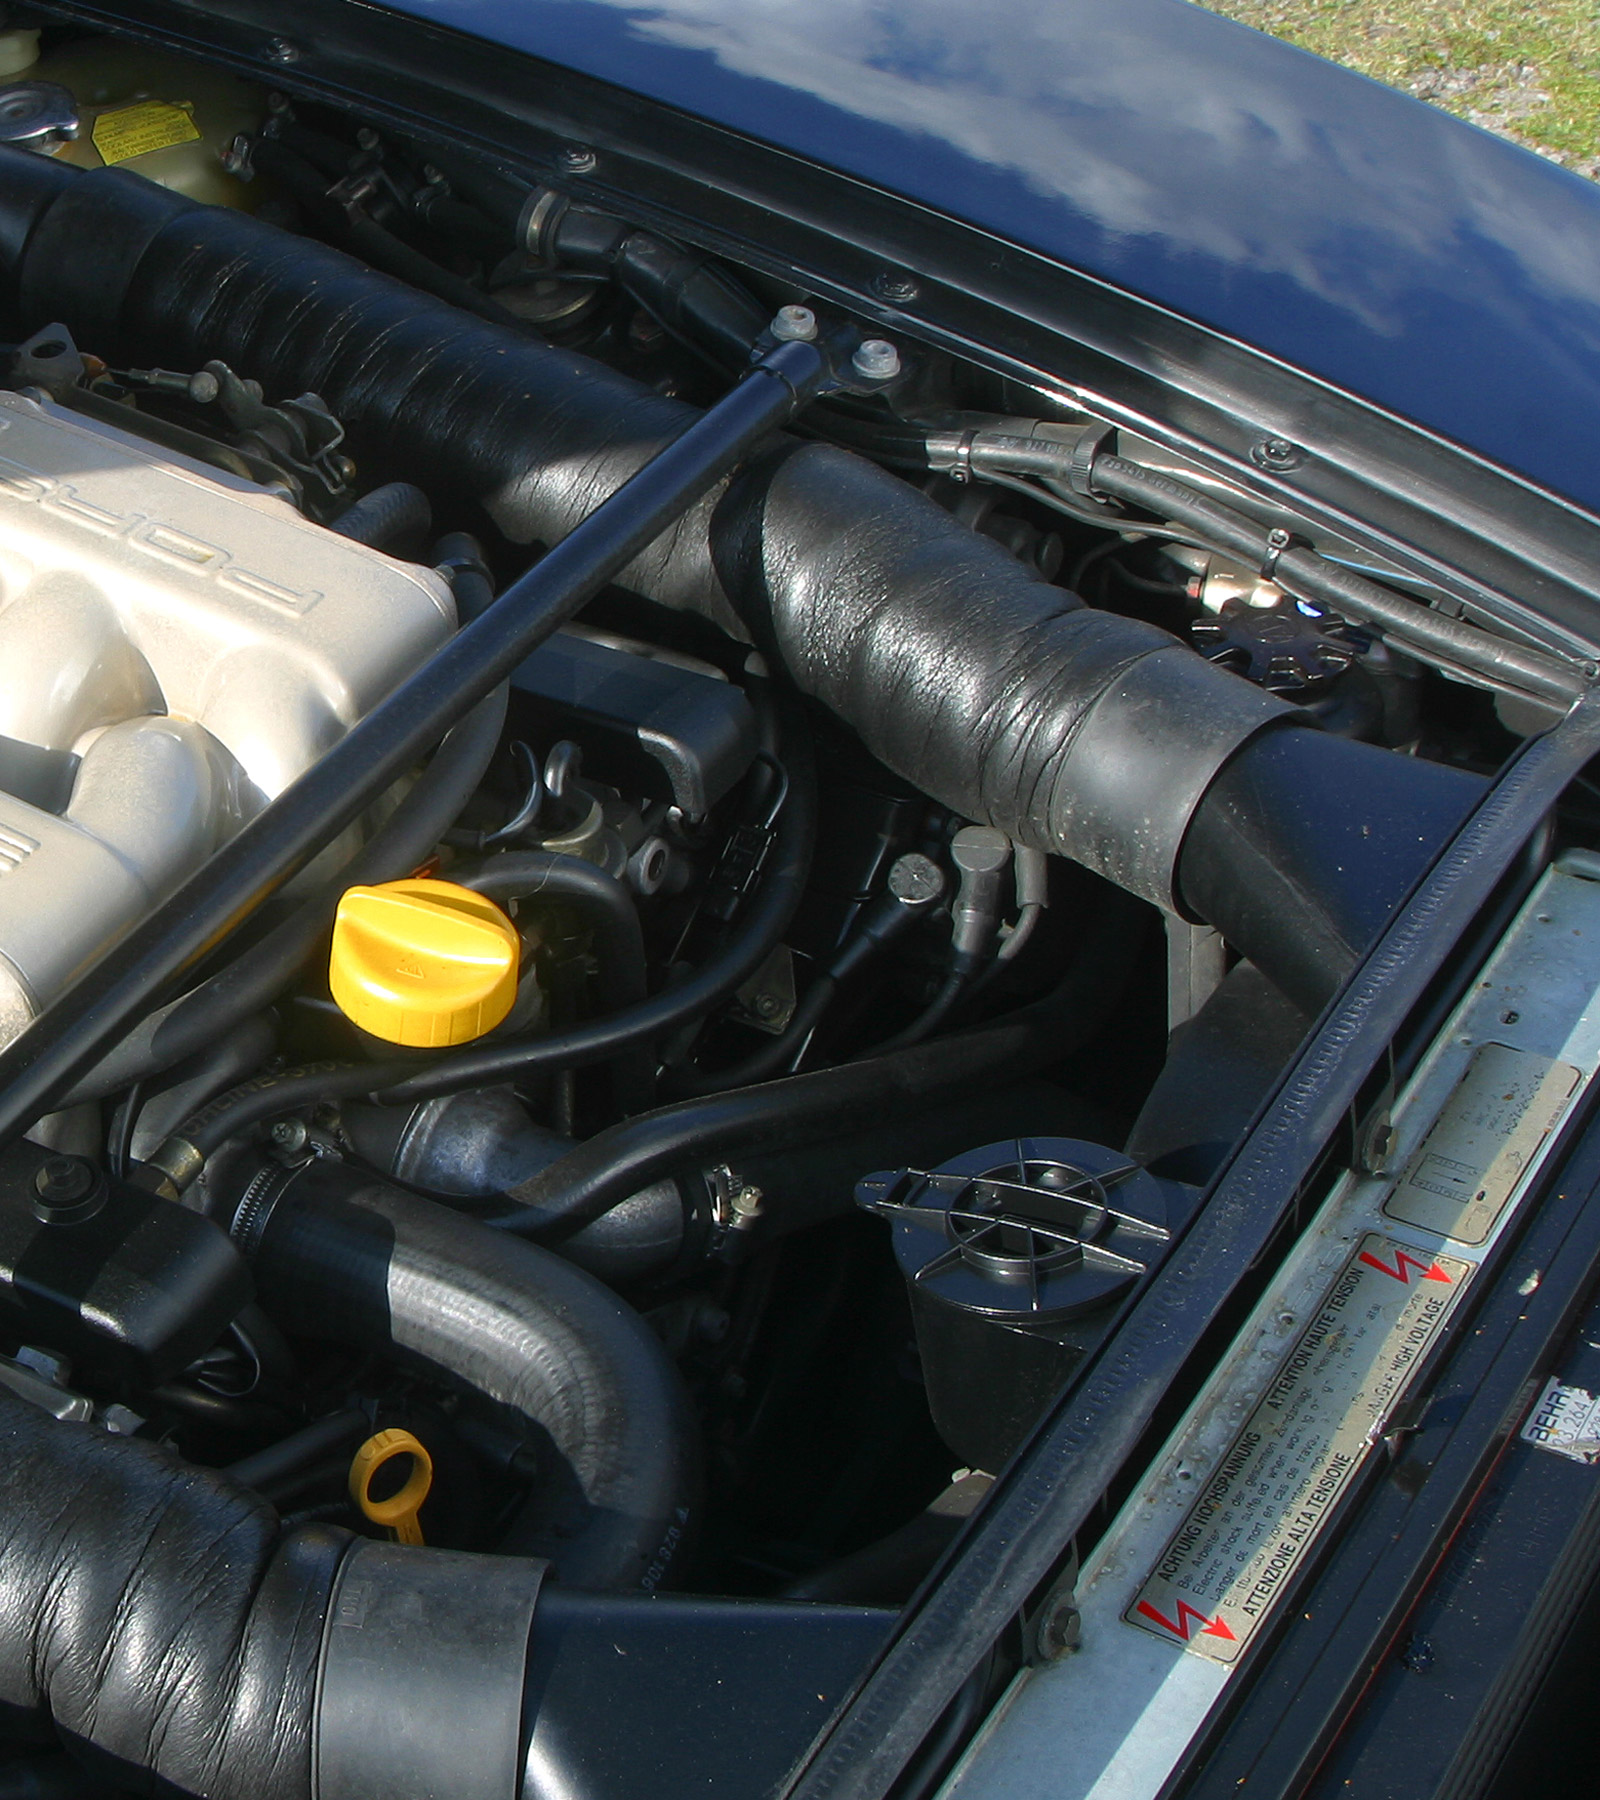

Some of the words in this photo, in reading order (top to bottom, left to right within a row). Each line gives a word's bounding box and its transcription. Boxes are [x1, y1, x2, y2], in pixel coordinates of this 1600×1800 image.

[1264, 1349, 1314, 1410] ATTENTION
[1302, 1313, 1336, 1349] HAUTE
[1325, 1267, 1365, 1313] TENSION
[1387, 1345, 1415, 1372] HIGH
[1403, 1296, 1445, 1345] VOLTAGE
[1529, 1390, 1571, 1442] BEHR
[1155, 1524, 1203, 1582] ACHTUNG
[1191, 1430, 1263, 1525] HOCHSPANNUNG
[1191, 1557, 1224, 1595] Electric
[1216, 1524, 1244, 1555] shock
[1237, 1482, 1270, 1522] suffeed
[1239, 1542, 1296, 1616] ATTENZIONE
[1285, 1509, 1316, 1542] ALTA
[1305, 1451, 1351, 1509] TENSIONE
